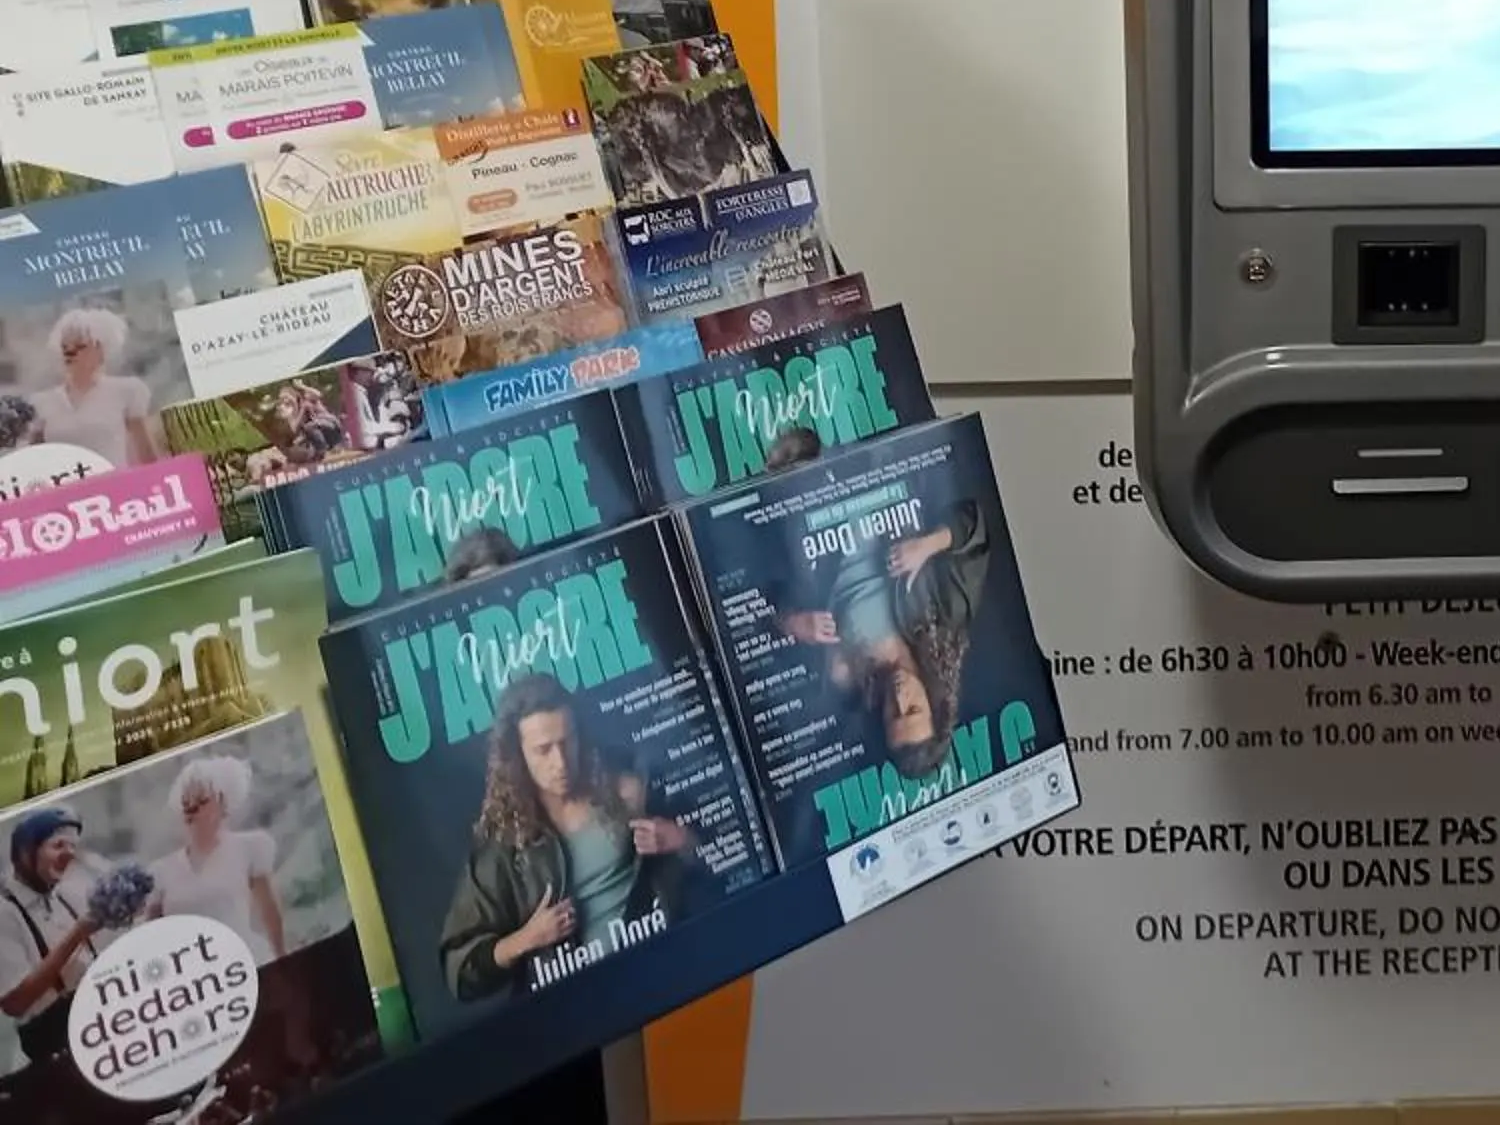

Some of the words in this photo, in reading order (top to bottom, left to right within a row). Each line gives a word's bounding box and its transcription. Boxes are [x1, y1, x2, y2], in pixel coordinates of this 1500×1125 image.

[25, 86, 51, 103] SITE
[219, 77, 281, 97] MARAIS
[283, 62, 354, 86] POITEVIN
[471, 163, 518, 180] Pineau
[529, 151, 578, 168] Cognac
[442, 230, 583, 287] MINES
[450, 258, 587, 313] D'ARGENT
[457, 308, 490, 327] DES
[492, 300, 529, 319] ROIS
[532, 281, 593, 307] FRANCS
[483, 363, 570, 415] FAMILY
[1072, 480, 1100, 505] et
[859, 497, 923, 541] Julien
[803, 522, 857, 572] Doré
[1044, 649, 1095, 676] ine
[1119, 648, 1153, 674] de
[1161, 646, 1230, 673] 6h30
[1238, 645, 1254, 671] à
[1264, 642, 1347, 671] 10h00
[1306, 684, 1361, 709] from
[1368, 684, 1418, 706] 6.30
[1425, 688, 1462, 705] am
[1469, 683, 1492, 704] to
[1116, 728, 1171, 751] from
[1179, 727, 1229, 750] 7.00
[1236, 731, 1272, 748] am
[1280, 727, 1302, 748] to
[1311, 724, 1375, 746] 10.00
[1382, 728, 1418, 745] am
[1425, 726, 1454, 743] on
[1010, 827, 1115, 858] VOTRE
[1124, 820, 1252, 855] DÉPART,
[1261, 817, 1430, 851] N'OUBLIEZ
[1440, 814, 1498, 846] PAS
[1283, 860, 1332, 890] OU
[1341, 857, 1431, 888] DANS
[1440, 855, 1495, 886] LES
[1135, 914, 1184, 943] ON
[1194, 908, 1386, 941] DEPARTURE,
[1398, 907, 1444, 936] DO
[1264, 950, 1303, 978] AT
[1312, 948, 1372, 976] THE
[79, 959, 249, 1049] dedans
